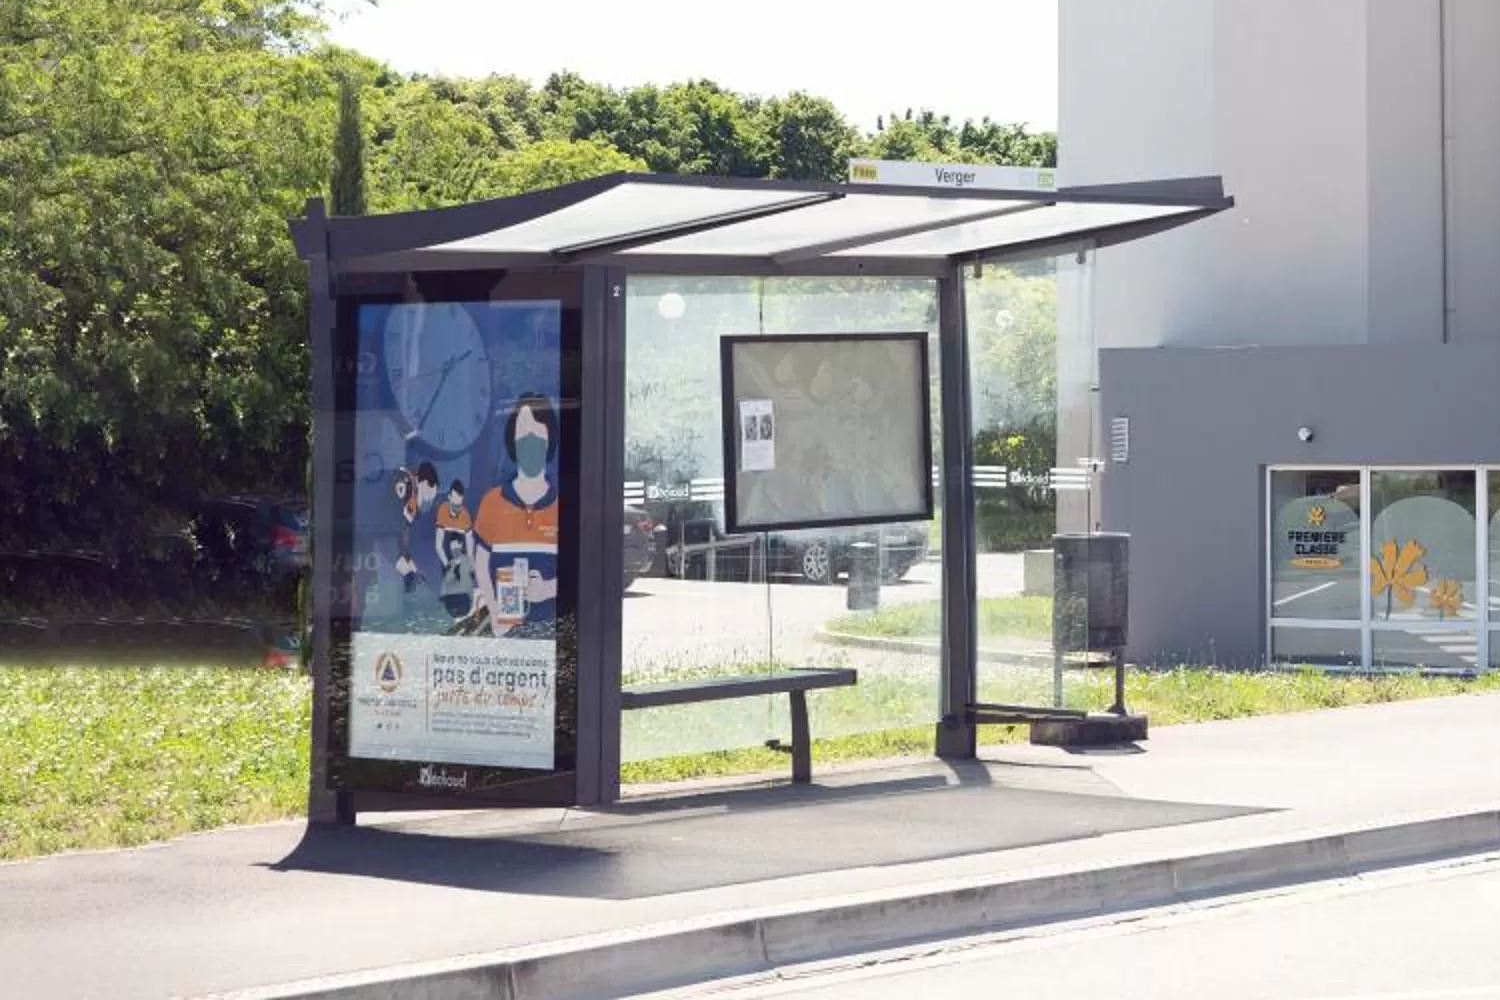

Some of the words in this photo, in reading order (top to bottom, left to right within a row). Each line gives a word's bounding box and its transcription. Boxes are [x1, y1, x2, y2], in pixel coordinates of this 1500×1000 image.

[935, 168, 976, 187] Verger
[433, 668, 465, 690] pas
[470, 666, 548, 693] d'argent
